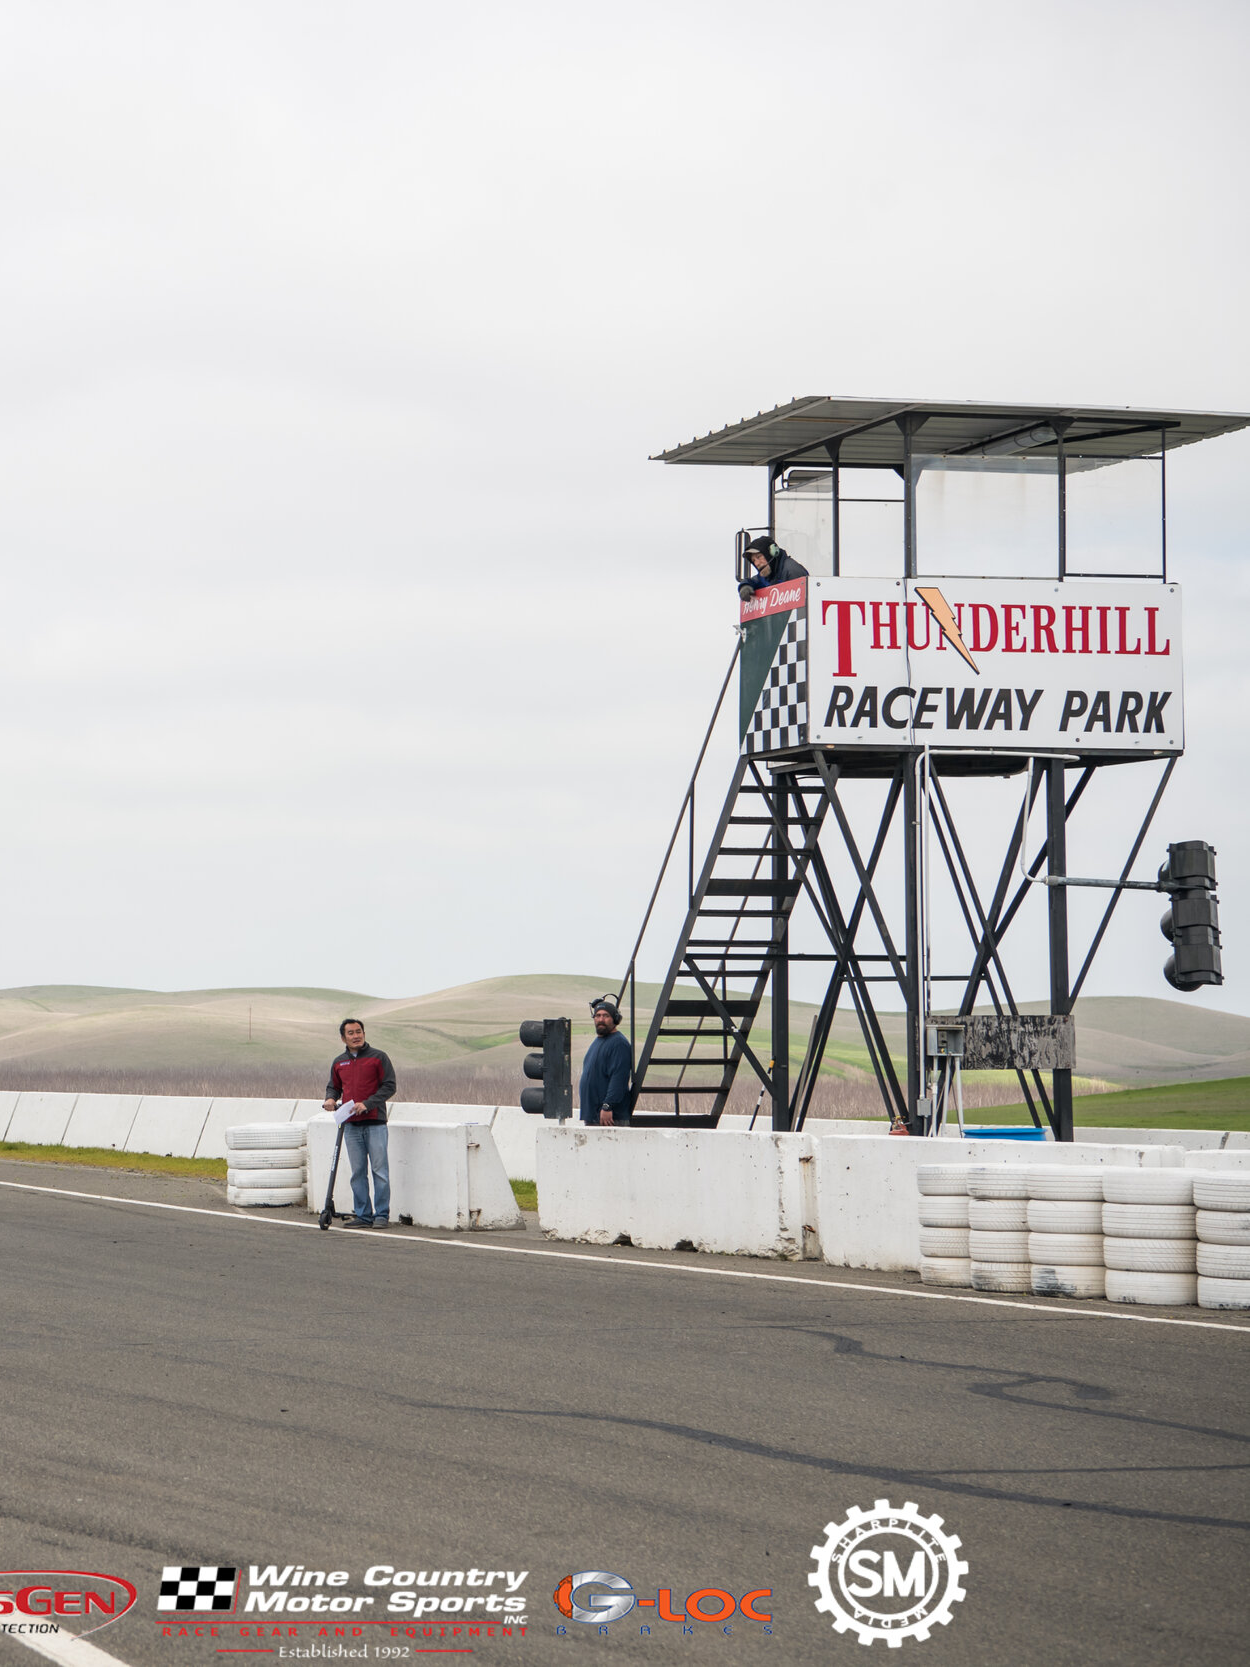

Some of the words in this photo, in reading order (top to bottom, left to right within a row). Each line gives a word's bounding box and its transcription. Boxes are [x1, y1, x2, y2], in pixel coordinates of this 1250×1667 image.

[770, 587, 801, 607] Deane
[822, 600, 1170, 677] THUNDERHILL
[823, 685, 1044, 731] RACEWAY
[1058, 690, 1172, 733] PARK
